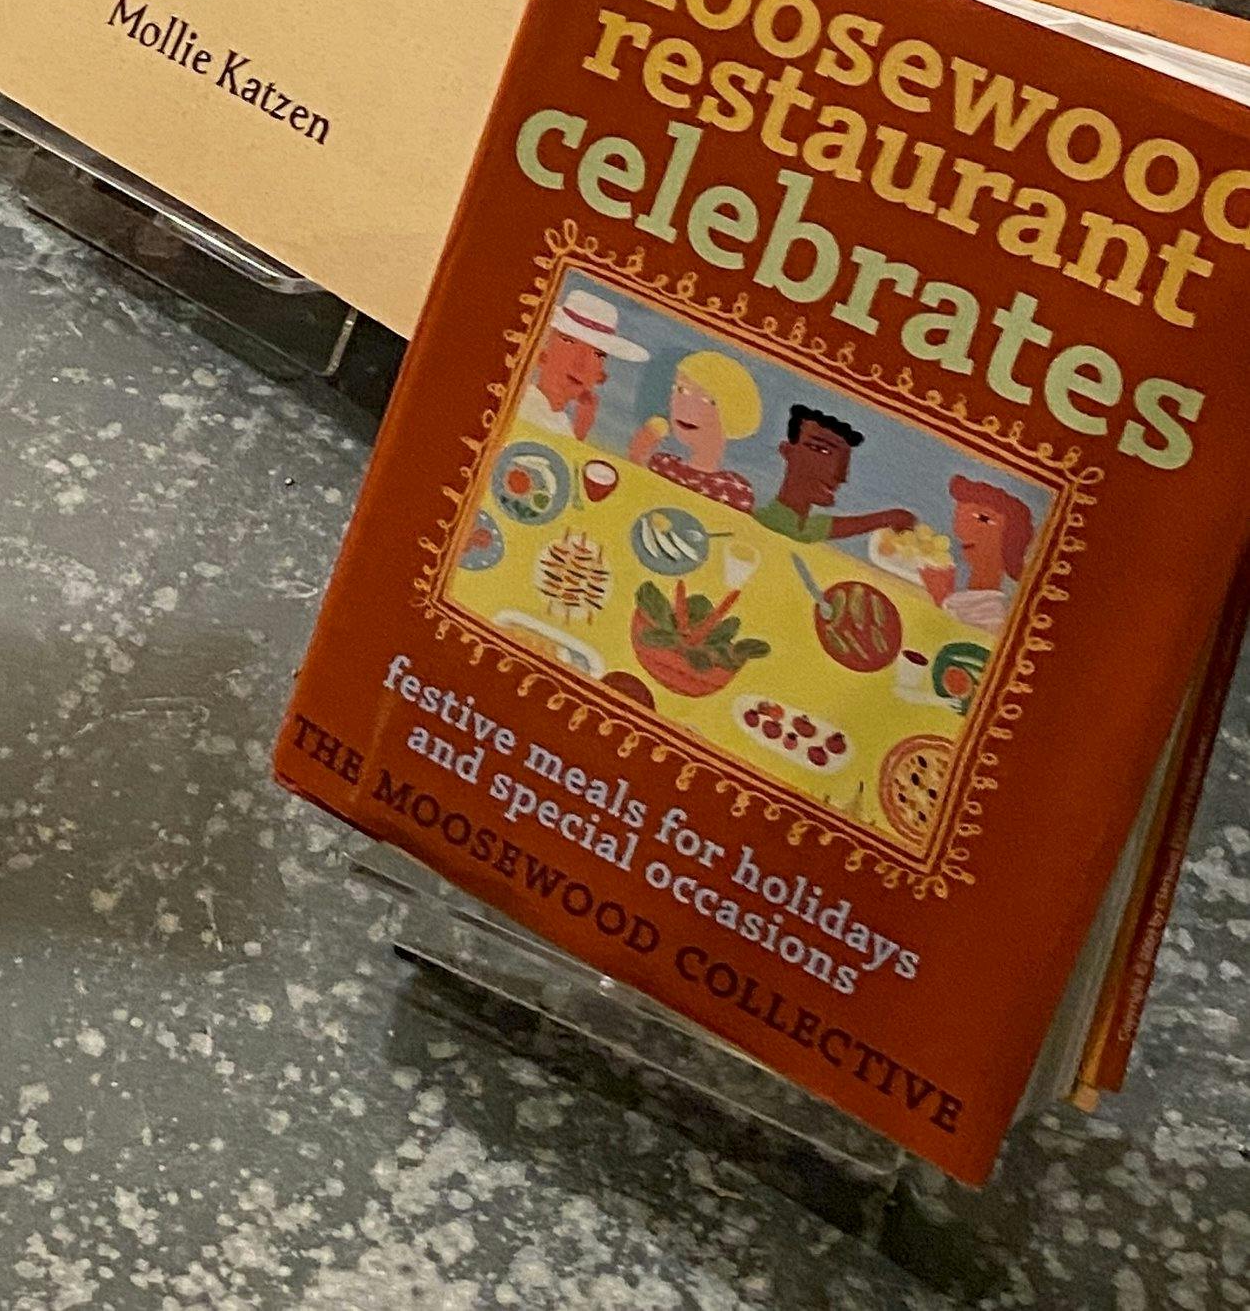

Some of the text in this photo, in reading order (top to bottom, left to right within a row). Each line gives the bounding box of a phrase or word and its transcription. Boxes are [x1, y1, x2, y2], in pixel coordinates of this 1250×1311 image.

[215, 48, 332, 146] Katzen
[582, 9, 1216, 329] restaurant
[514, 108, 1206, 472] celebrates
[291, 713, 964, 1135] THE MOOSEWOOD COLLECTIVE
[383, 655, 921, 982] festive meals for holidays
[406, 723, 860, 996] and special occasions
